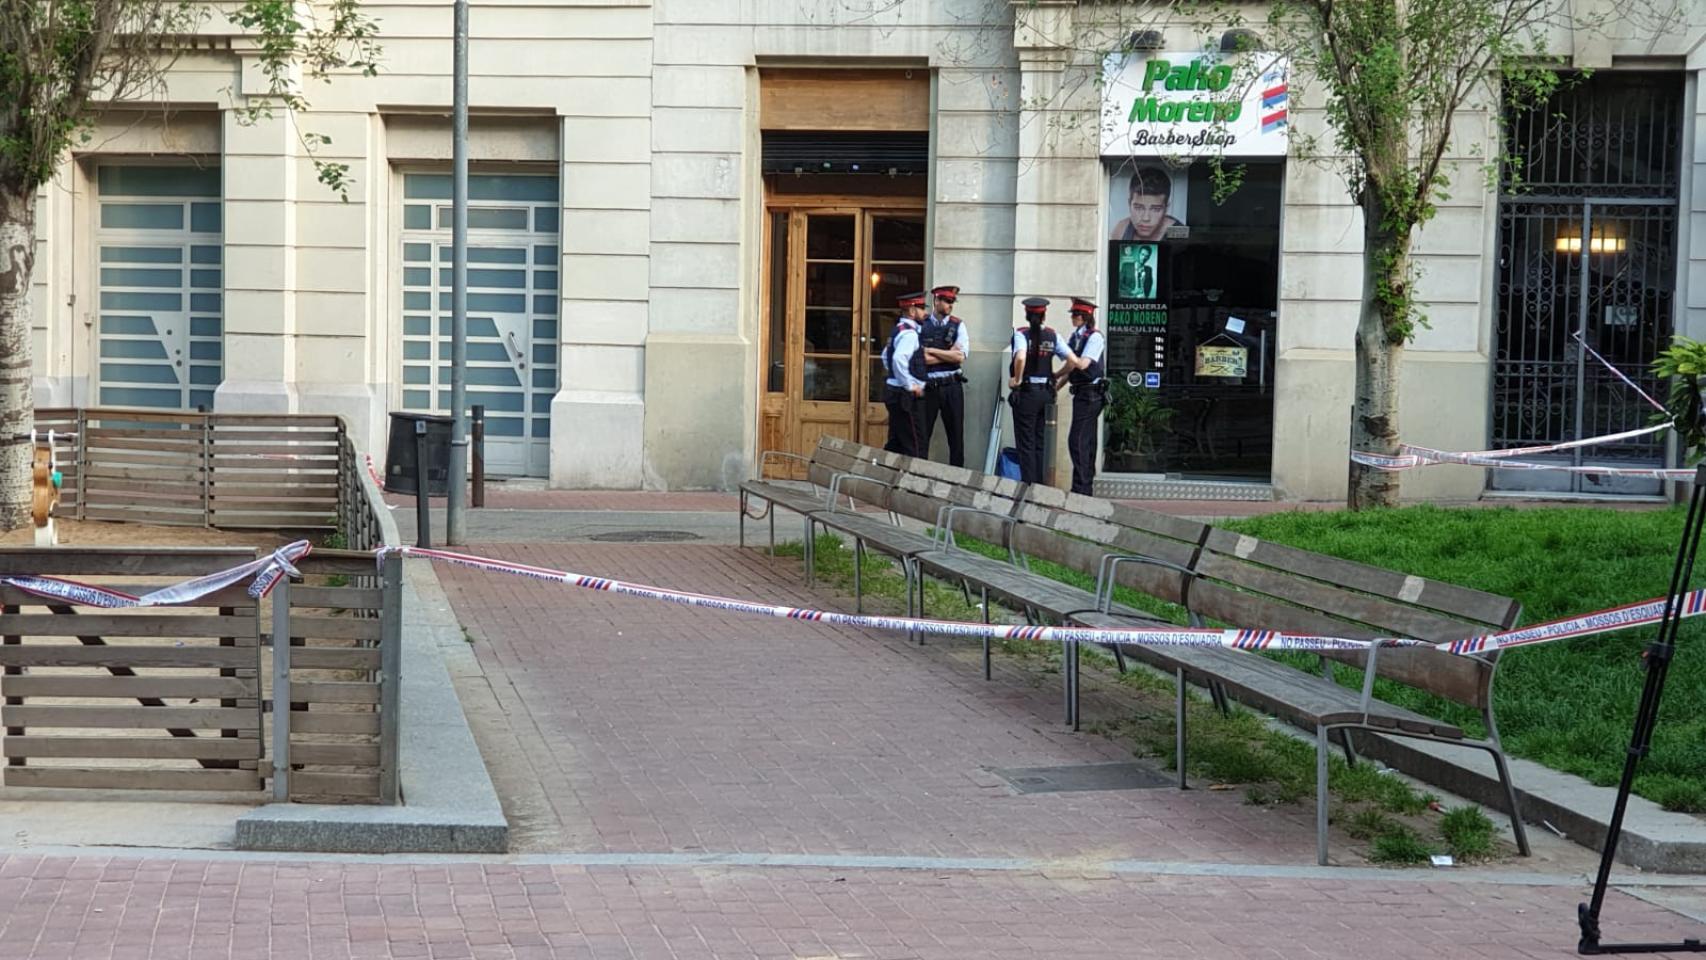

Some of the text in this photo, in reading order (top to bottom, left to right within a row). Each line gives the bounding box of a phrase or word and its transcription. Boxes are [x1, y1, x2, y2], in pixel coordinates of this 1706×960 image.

[1142, 60, 1233, 92] Pako
[1128, 96, 1242, 122] Moreno
[1133, 129, 1237, 148] BarberShop
[1108, 311, 1168, 325] PAKO MORENO
[1496, 635, 1509, 644] NO
[1510, 629, 1542, 642] PASSEU
[1547, 621, 1581, 635] POLICIA
[1585, 612, 1621, 628] MOSSOS
[1052, 629, 1063, 640] NO
[1065, 630, 1095, 641] PASSEU
[1101, 631, 1131, 643] POLICIA
[1138, 632, 1170, 645] MOSSOS
[1172, 633, 1222, 647] D'ESQUADRA
[1281, 637, 1292, 648] NO
[1294, 638, 1326, 649] PASSEU
